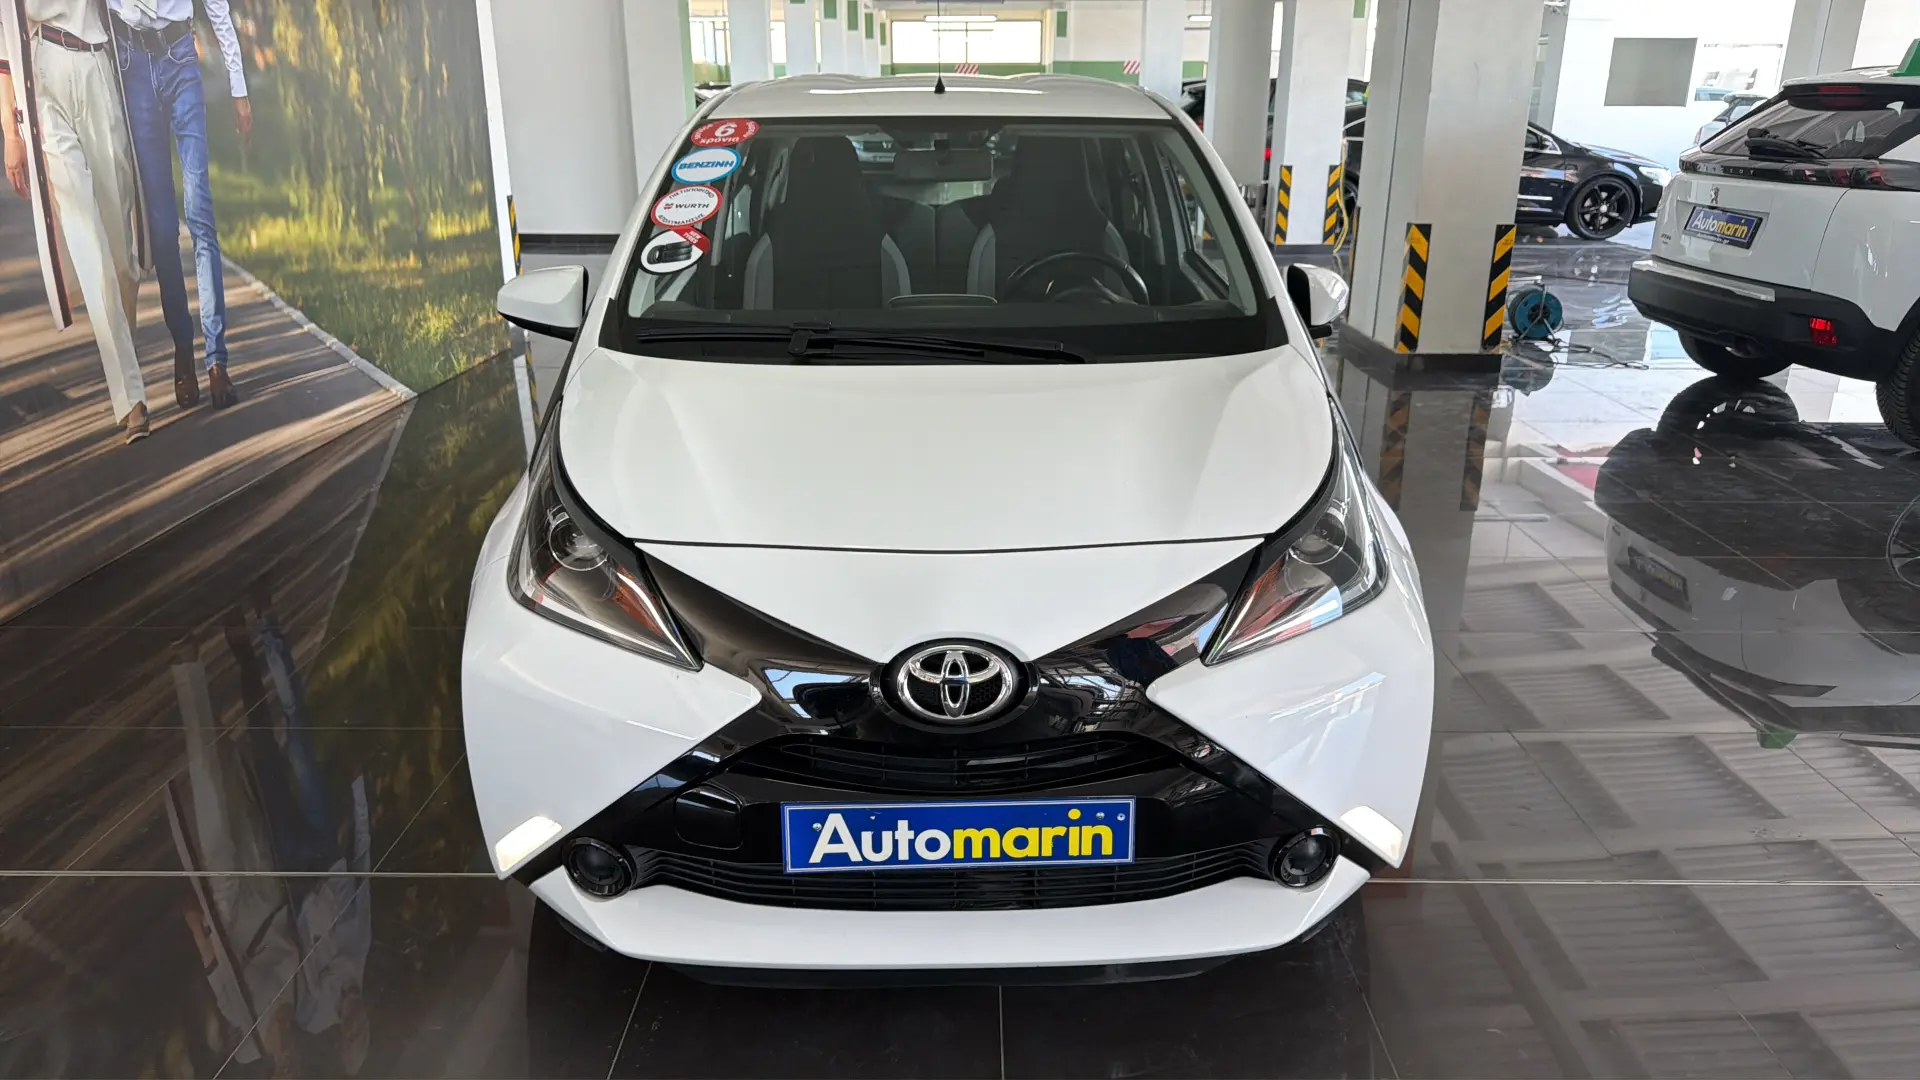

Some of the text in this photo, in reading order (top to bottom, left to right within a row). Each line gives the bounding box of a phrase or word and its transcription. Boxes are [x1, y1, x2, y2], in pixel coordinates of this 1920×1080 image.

[715, 122, 738, 138] 6
[1691, 210, 1748, 239] Automarin
[808, 808, 1113, 864] Automarin
